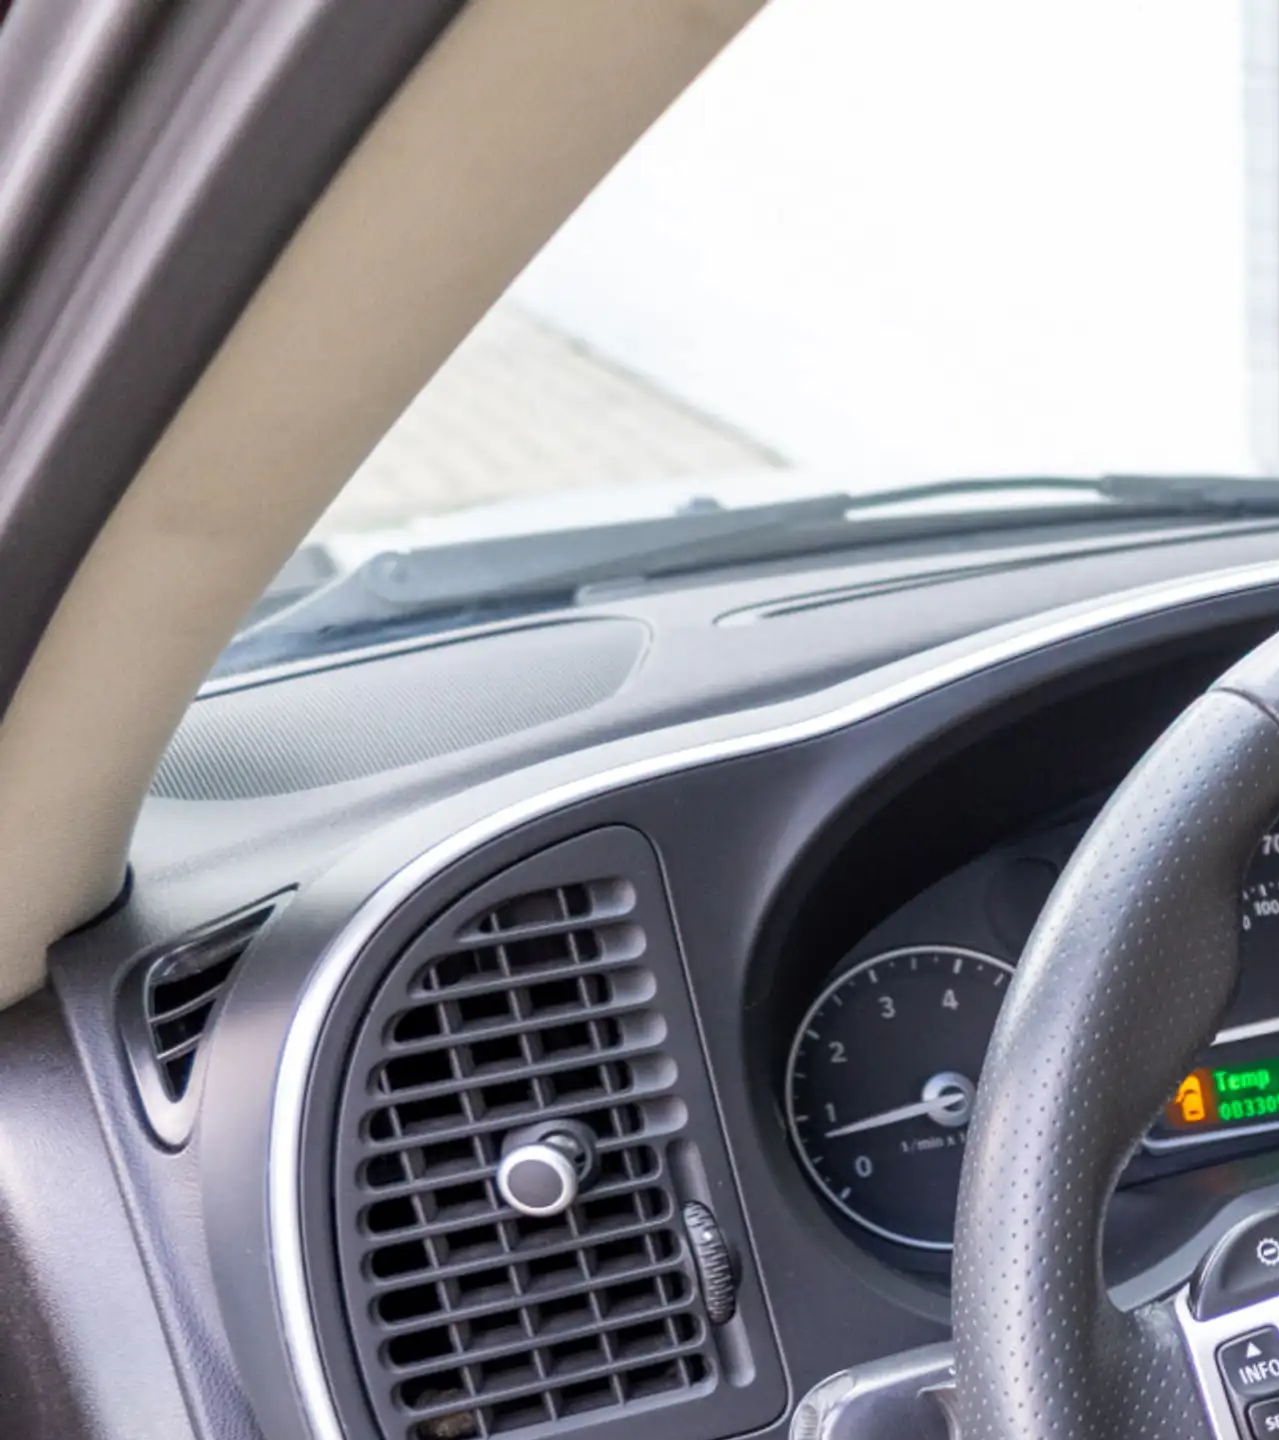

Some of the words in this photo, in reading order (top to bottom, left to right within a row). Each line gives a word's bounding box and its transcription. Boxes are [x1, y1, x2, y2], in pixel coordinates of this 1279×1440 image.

[1254, 899, 1279, 916] 100
[878, 995, 897, 1019] 3
[941, 989, 960, 1010] 4
[828, 1040, 848, 1063] 2
[1213, 1068, 1271, 1093] Temp
[825, 1102, 837, 1123] 1
[855, 1156, 873, 1177] 0
